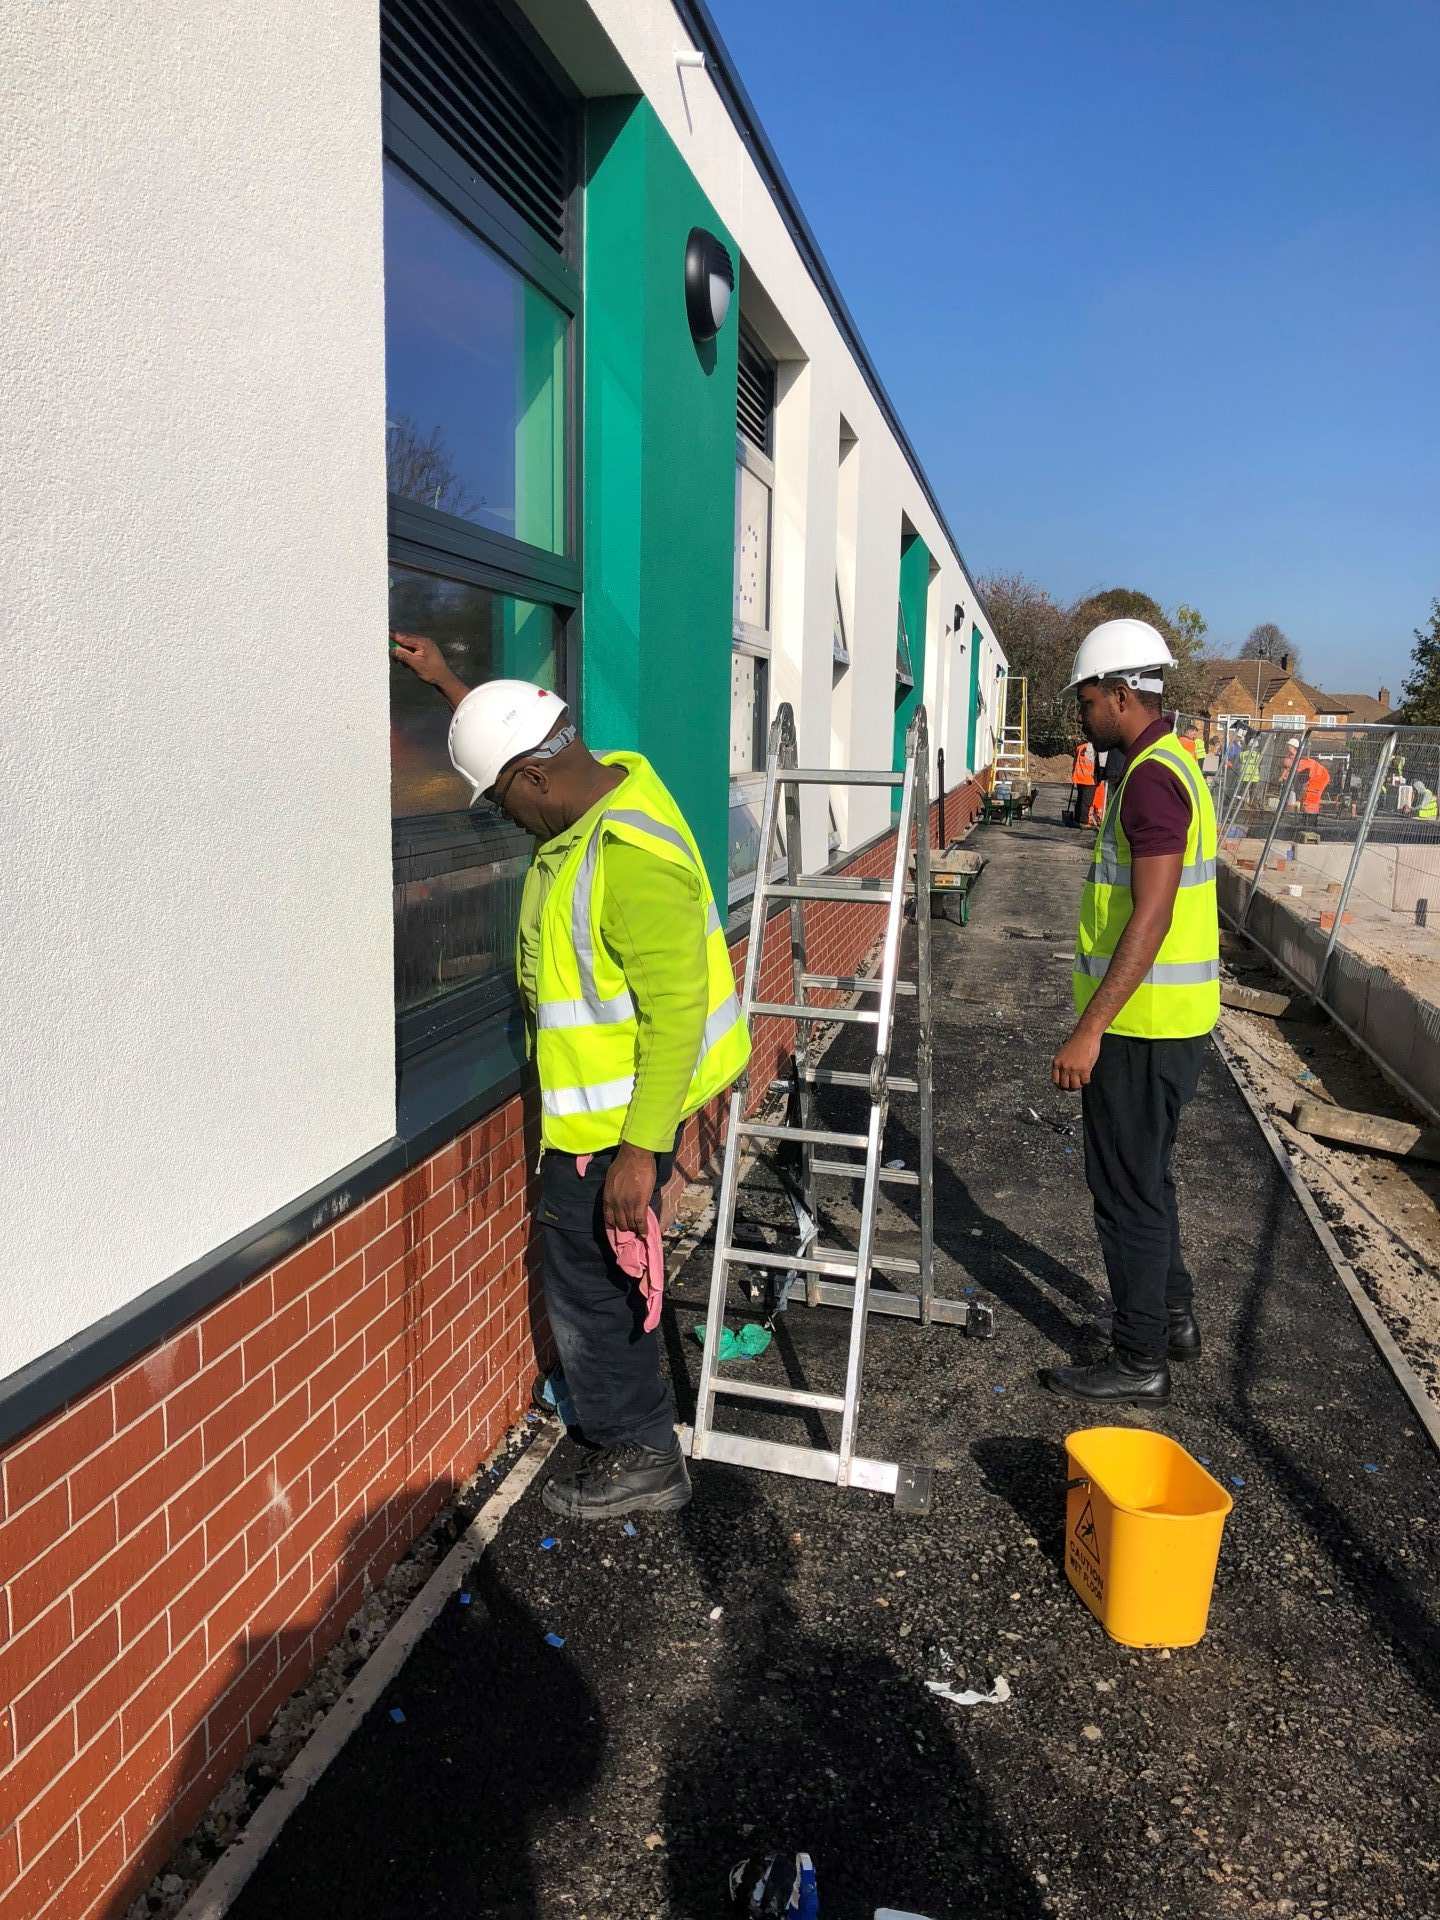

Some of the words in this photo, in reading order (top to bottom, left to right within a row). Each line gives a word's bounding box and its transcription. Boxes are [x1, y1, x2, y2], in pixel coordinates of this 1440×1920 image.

[1070, 1540, 1104, 1590] CAUTION
[1070, 1554, 1082, 1576] WET
[1083, 1571, 1103, 1604] FLOOR
